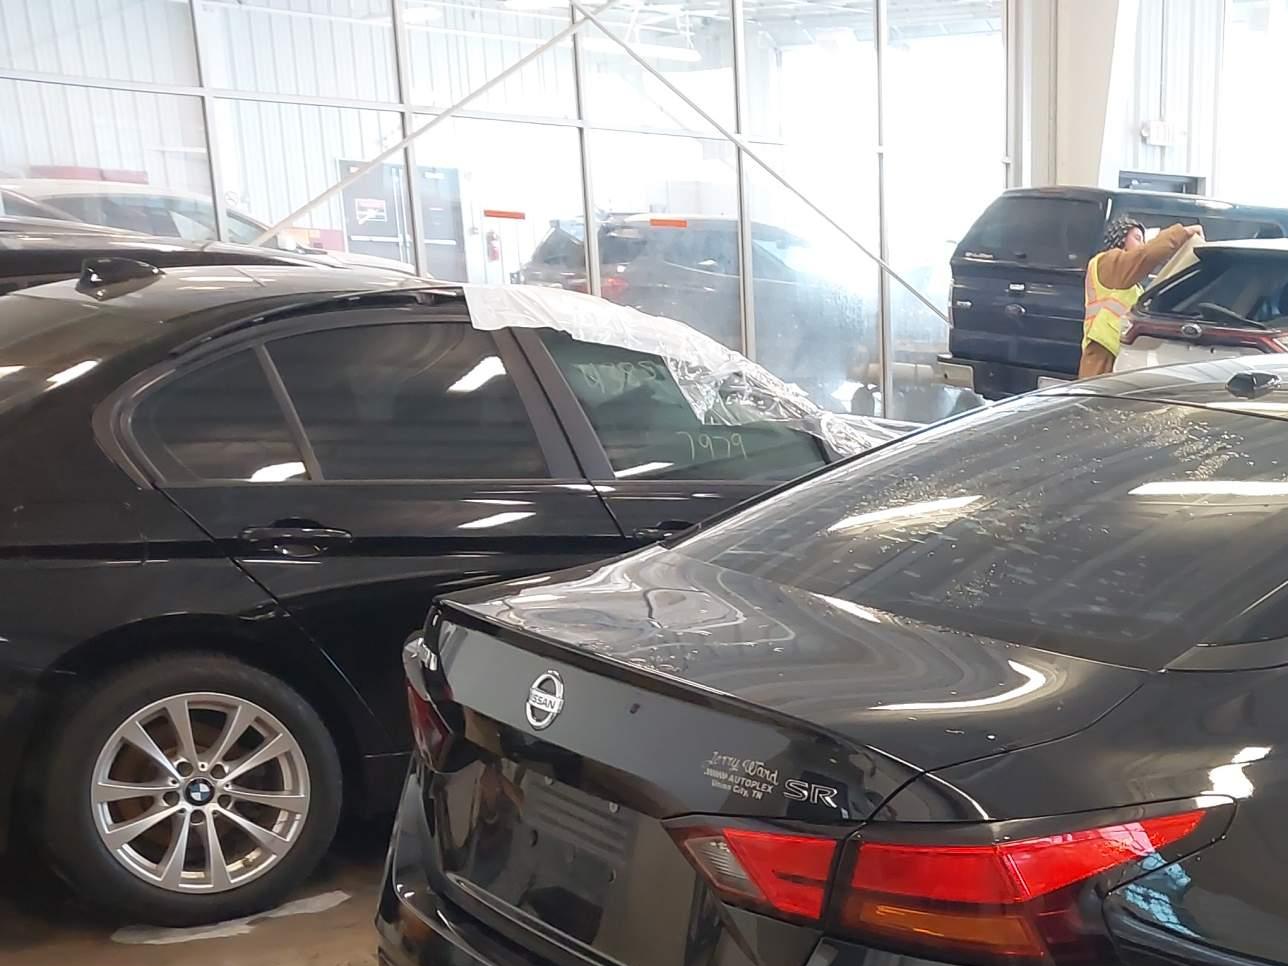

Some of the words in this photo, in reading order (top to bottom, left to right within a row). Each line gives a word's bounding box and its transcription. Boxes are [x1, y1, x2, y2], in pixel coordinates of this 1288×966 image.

[676, 431, 748, 461] 7979
[729, 774, 774, 794] AUTOPLEX
[742, 759, 779, 786] Ward
[783, 778, 838, 808] SR
